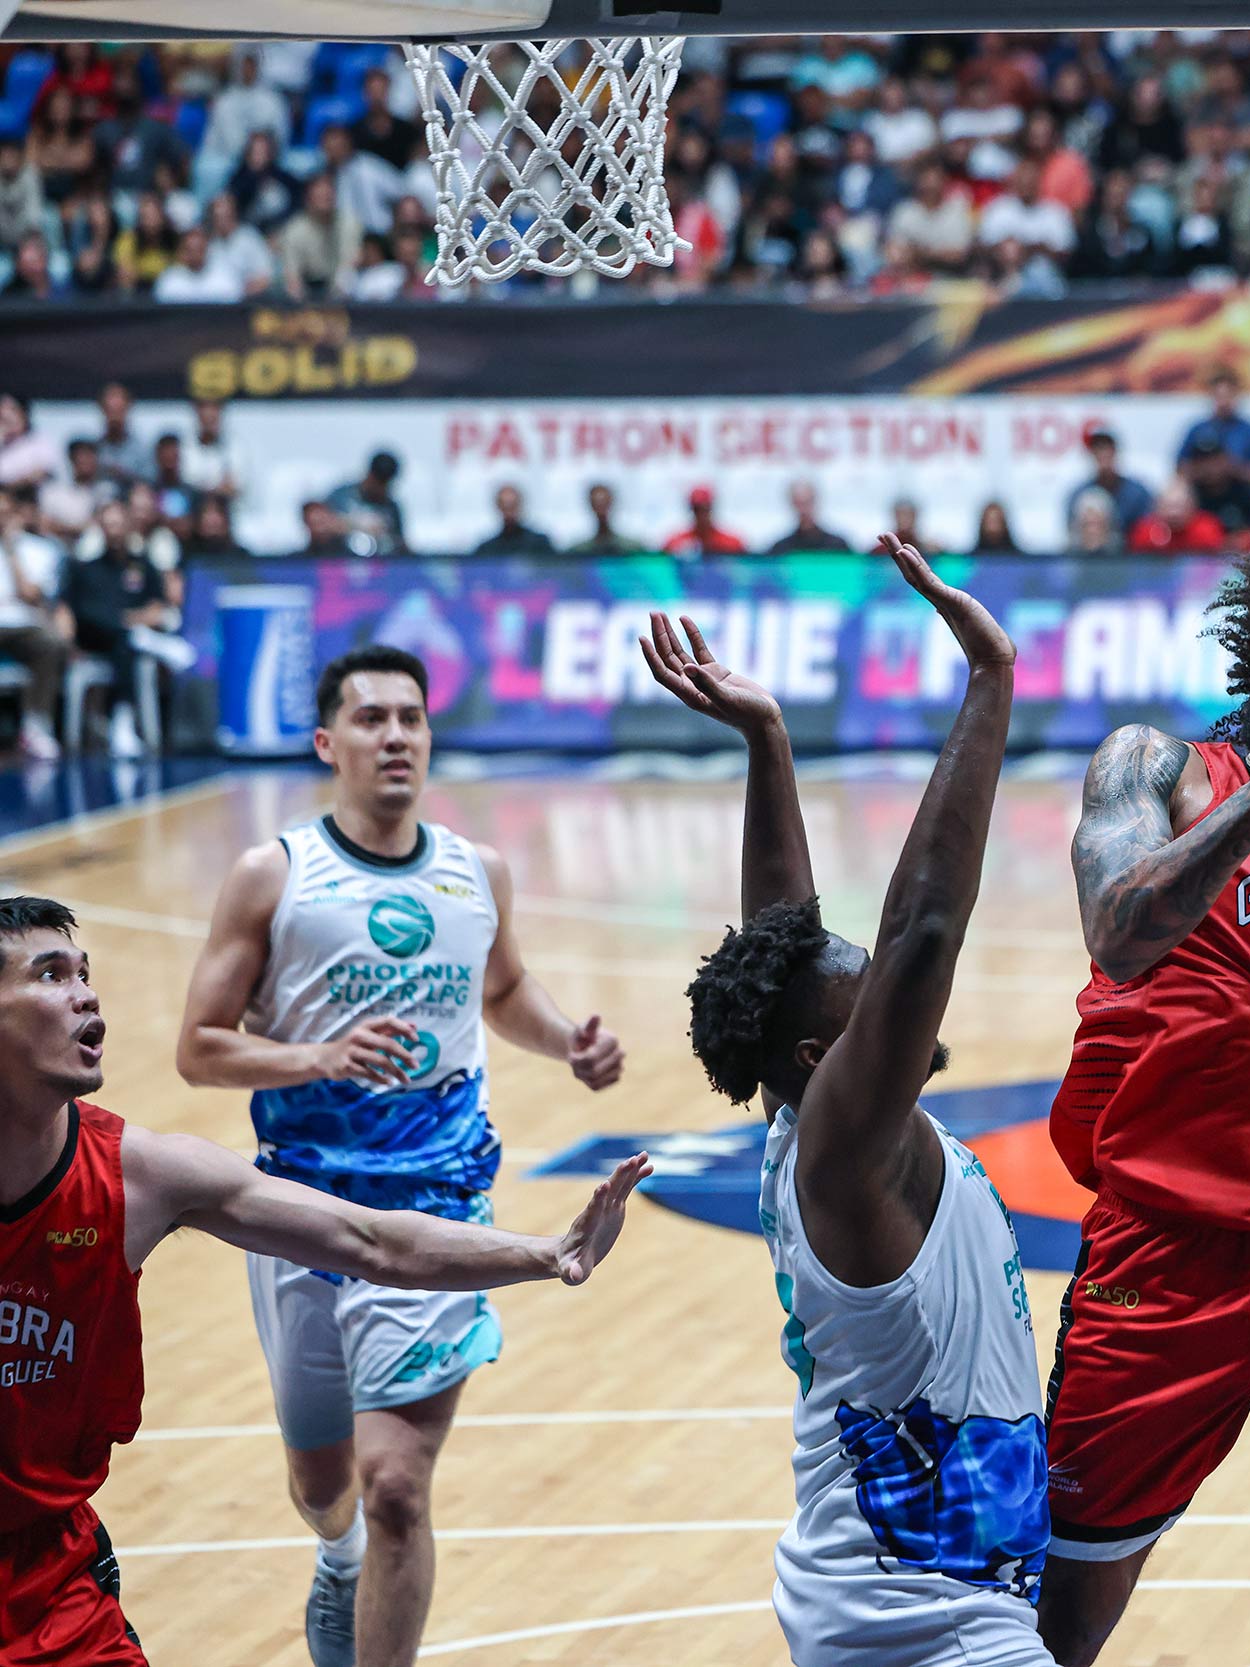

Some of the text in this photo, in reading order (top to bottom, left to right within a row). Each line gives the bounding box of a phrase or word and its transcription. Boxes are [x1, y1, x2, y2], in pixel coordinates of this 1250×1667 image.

[189, 335, 417, 400] SOLID
[447, 417, 697, 464] PATRON
[714, 415, 983, 462] SECTION
[327, 963, 473, 983] PHOENIX
